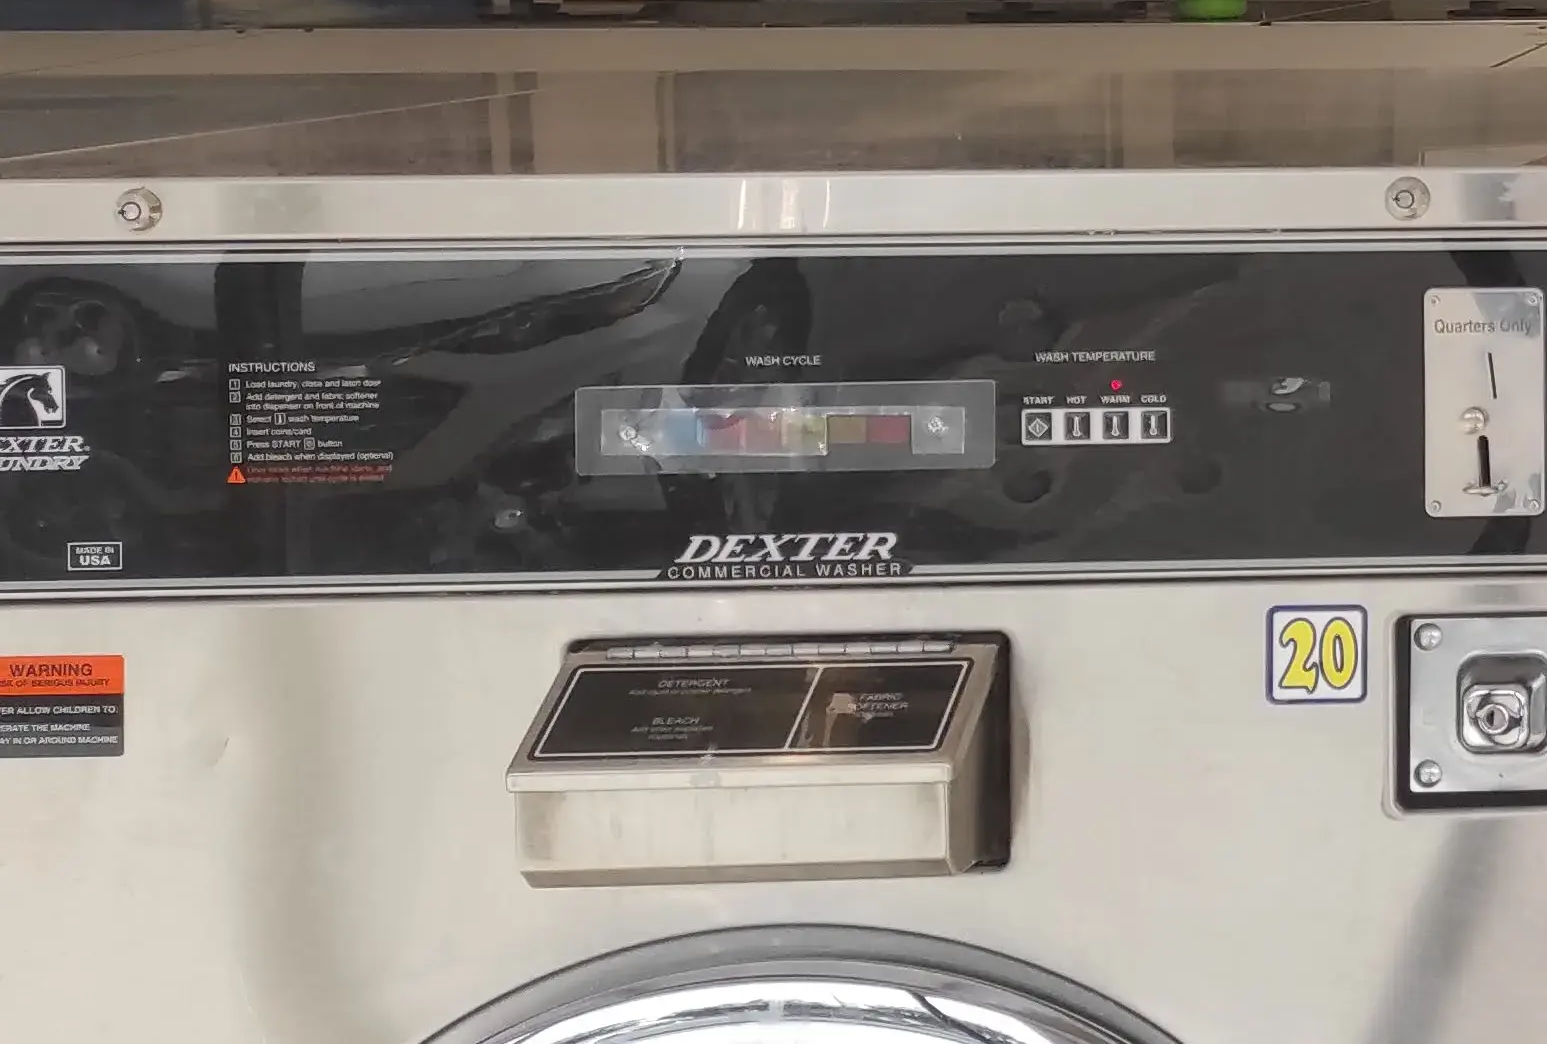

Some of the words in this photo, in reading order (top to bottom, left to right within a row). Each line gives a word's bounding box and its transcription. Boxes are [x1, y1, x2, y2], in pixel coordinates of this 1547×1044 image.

[1434, 318, 1495, 334] Quarters
[1500, 318, 1532, 335] Only
[745, 355, 780, 367] WASH
[782, 355, 822, 367] CYCLE
[1035, 351, 1069, 363] WASH
[1071, 351, 1156, 363] TEMPERATURE
[228, 362, 316, 372] INSTRUCTIONS
[674, 532, 898, 564] DEXTER
[80, 555, 111, 566] USA
[667, 563, 806, 580] COMMERCIAL
[815, 562, 902, 578] WASHER
[1278, 616, 1356, 694] 20
[10, 664, 93, 677] WARNING
[17, 706, 51, 715] ALLOW
[53, 706, 101, 714] CHILDREN
